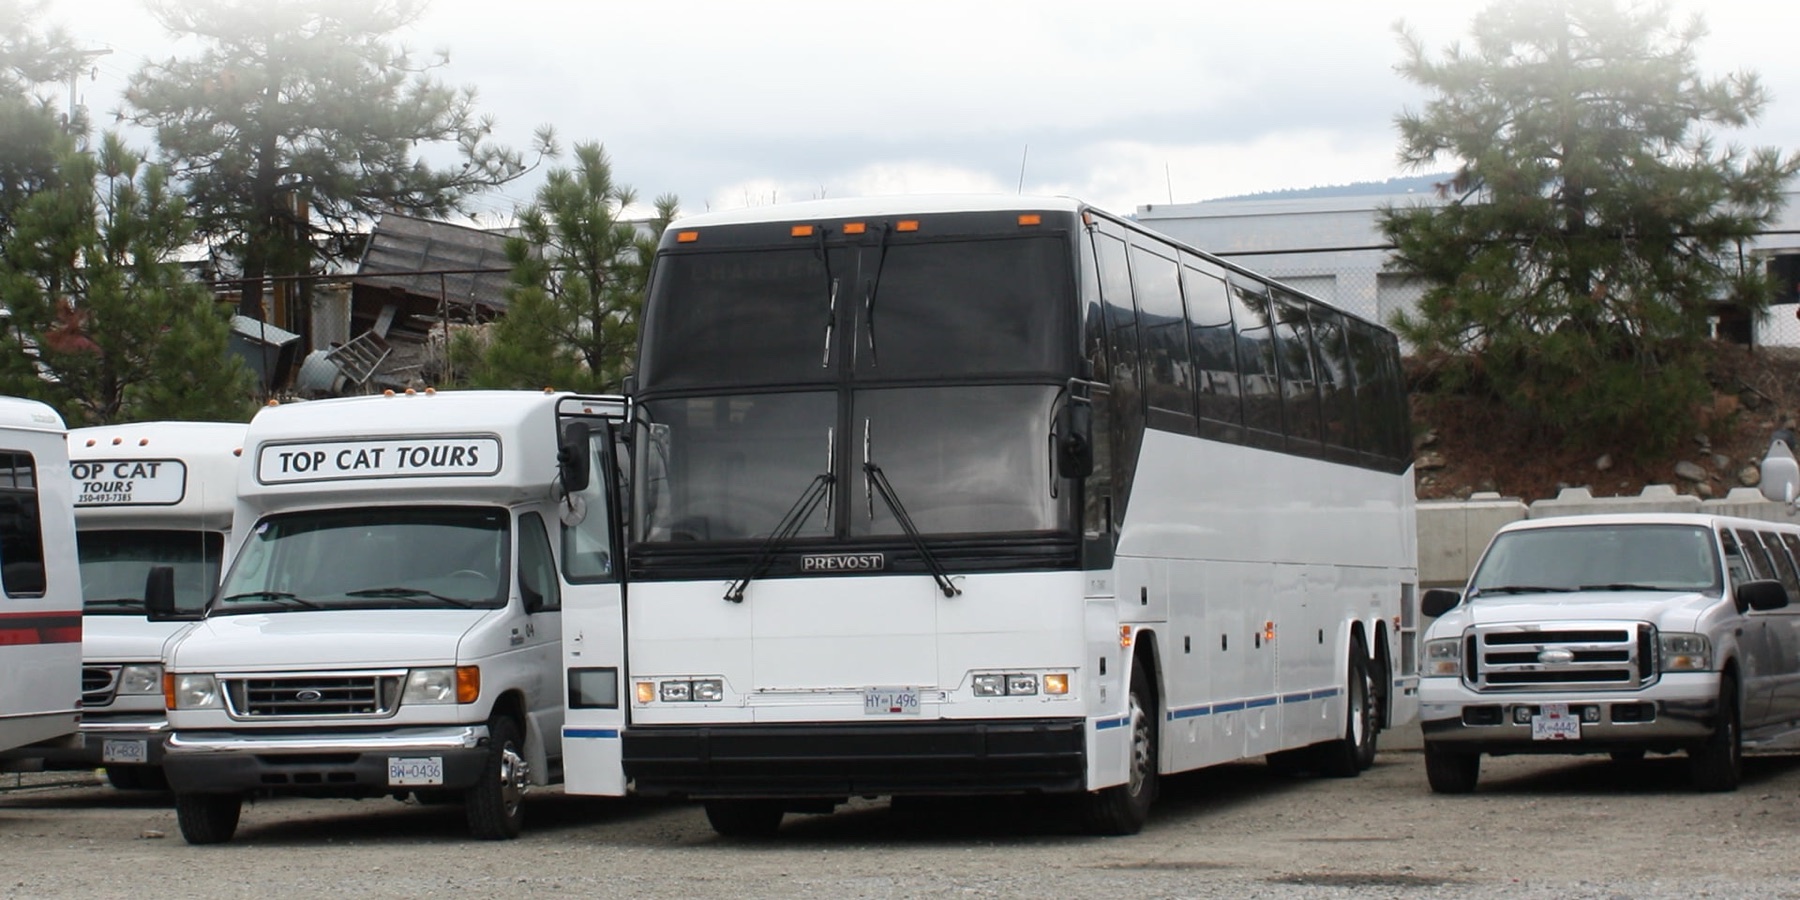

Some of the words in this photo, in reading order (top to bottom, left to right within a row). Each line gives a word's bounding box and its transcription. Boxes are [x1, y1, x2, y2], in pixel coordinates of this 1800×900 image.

[279, 450, 326, 473] TOP
[336, 448, 385, 471] CAT
[397, 445, 479, 468] TOURS
[70, 462, 104, 480] OP
[113, 462, 161, 479] CAT
[83, 481, 133, 493] TOURS
[78, 493, 132, 503] 250-493-7385
[804, 556, 881, 570] PREVOST
